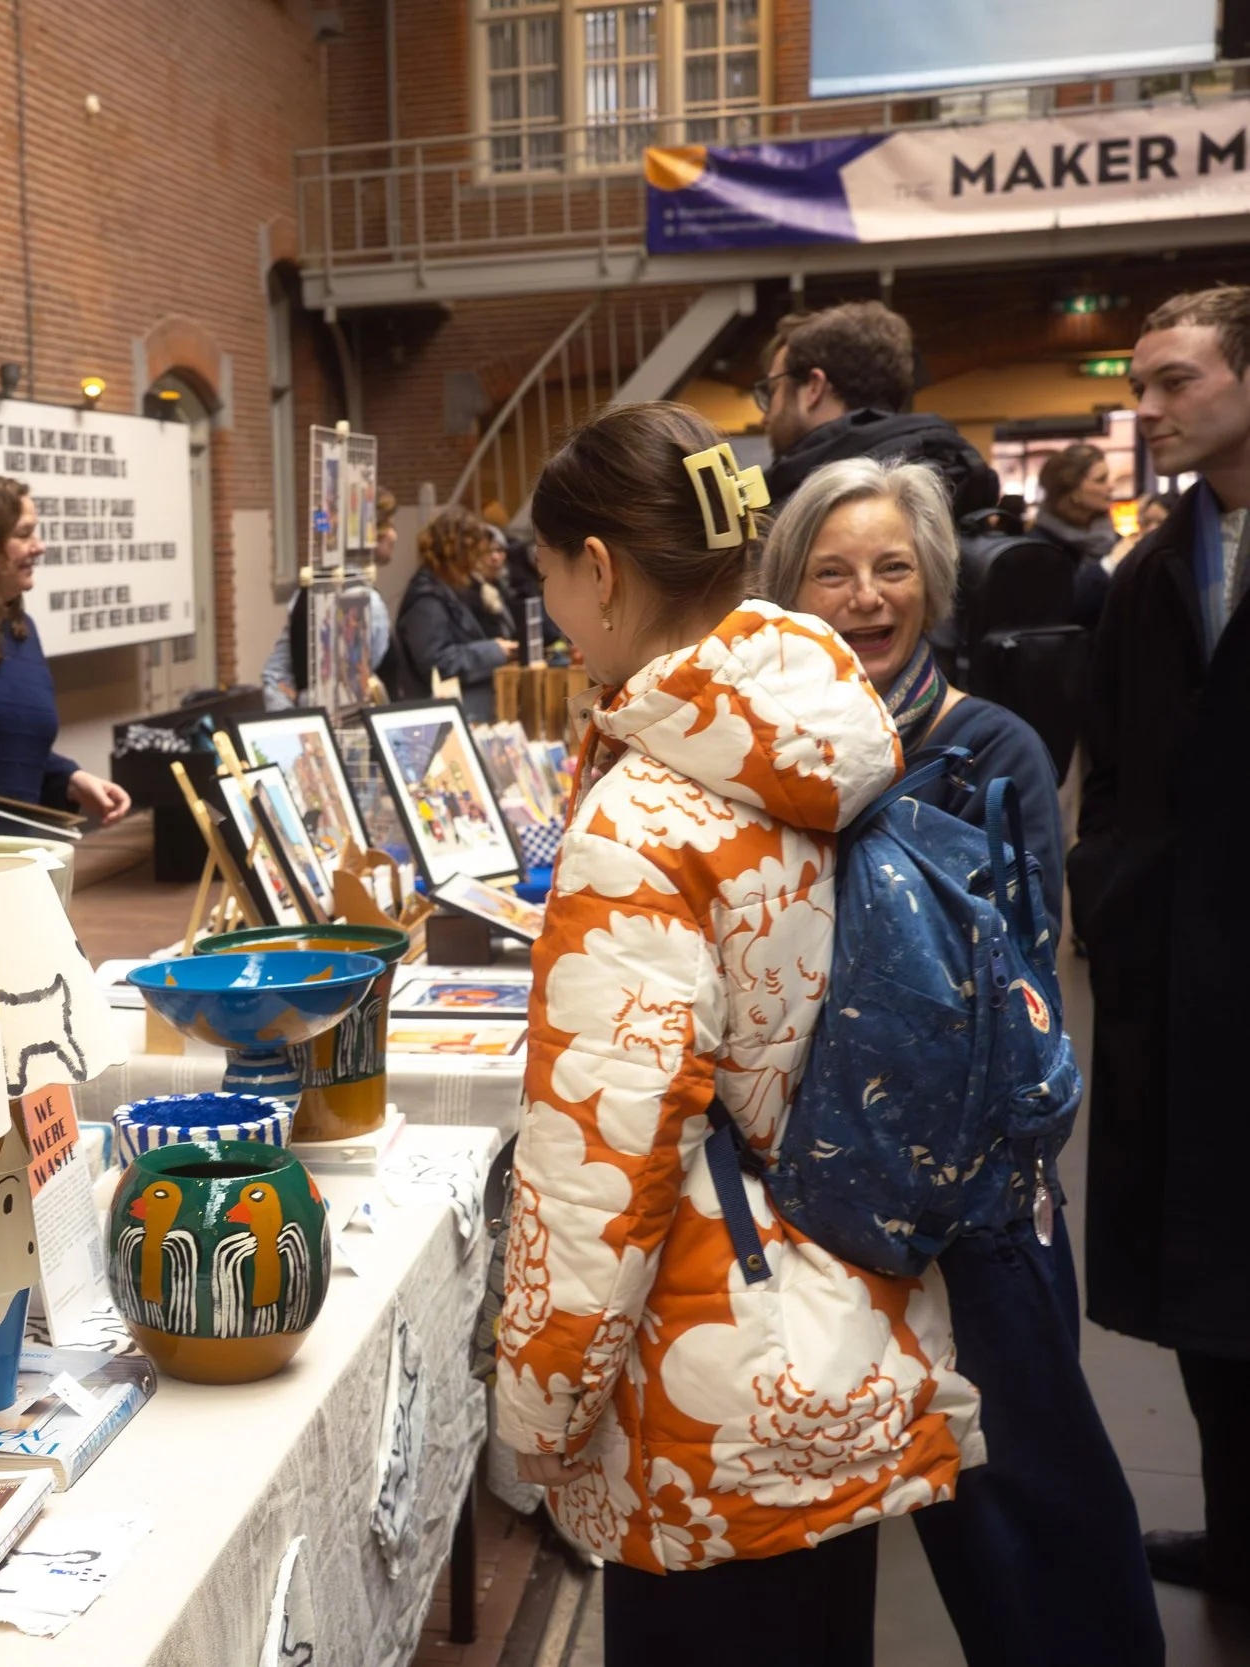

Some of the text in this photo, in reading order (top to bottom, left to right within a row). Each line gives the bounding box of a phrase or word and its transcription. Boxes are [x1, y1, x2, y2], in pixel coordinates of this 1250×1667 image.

[950, 134, 1178, 196] MAKER
[1197, 128, 1248, 174] M
[34, 1096, 55, 1123] WE
[32, 1117, 68, 1156] WERE
[34, 1140, 77, 1186] WASTE
